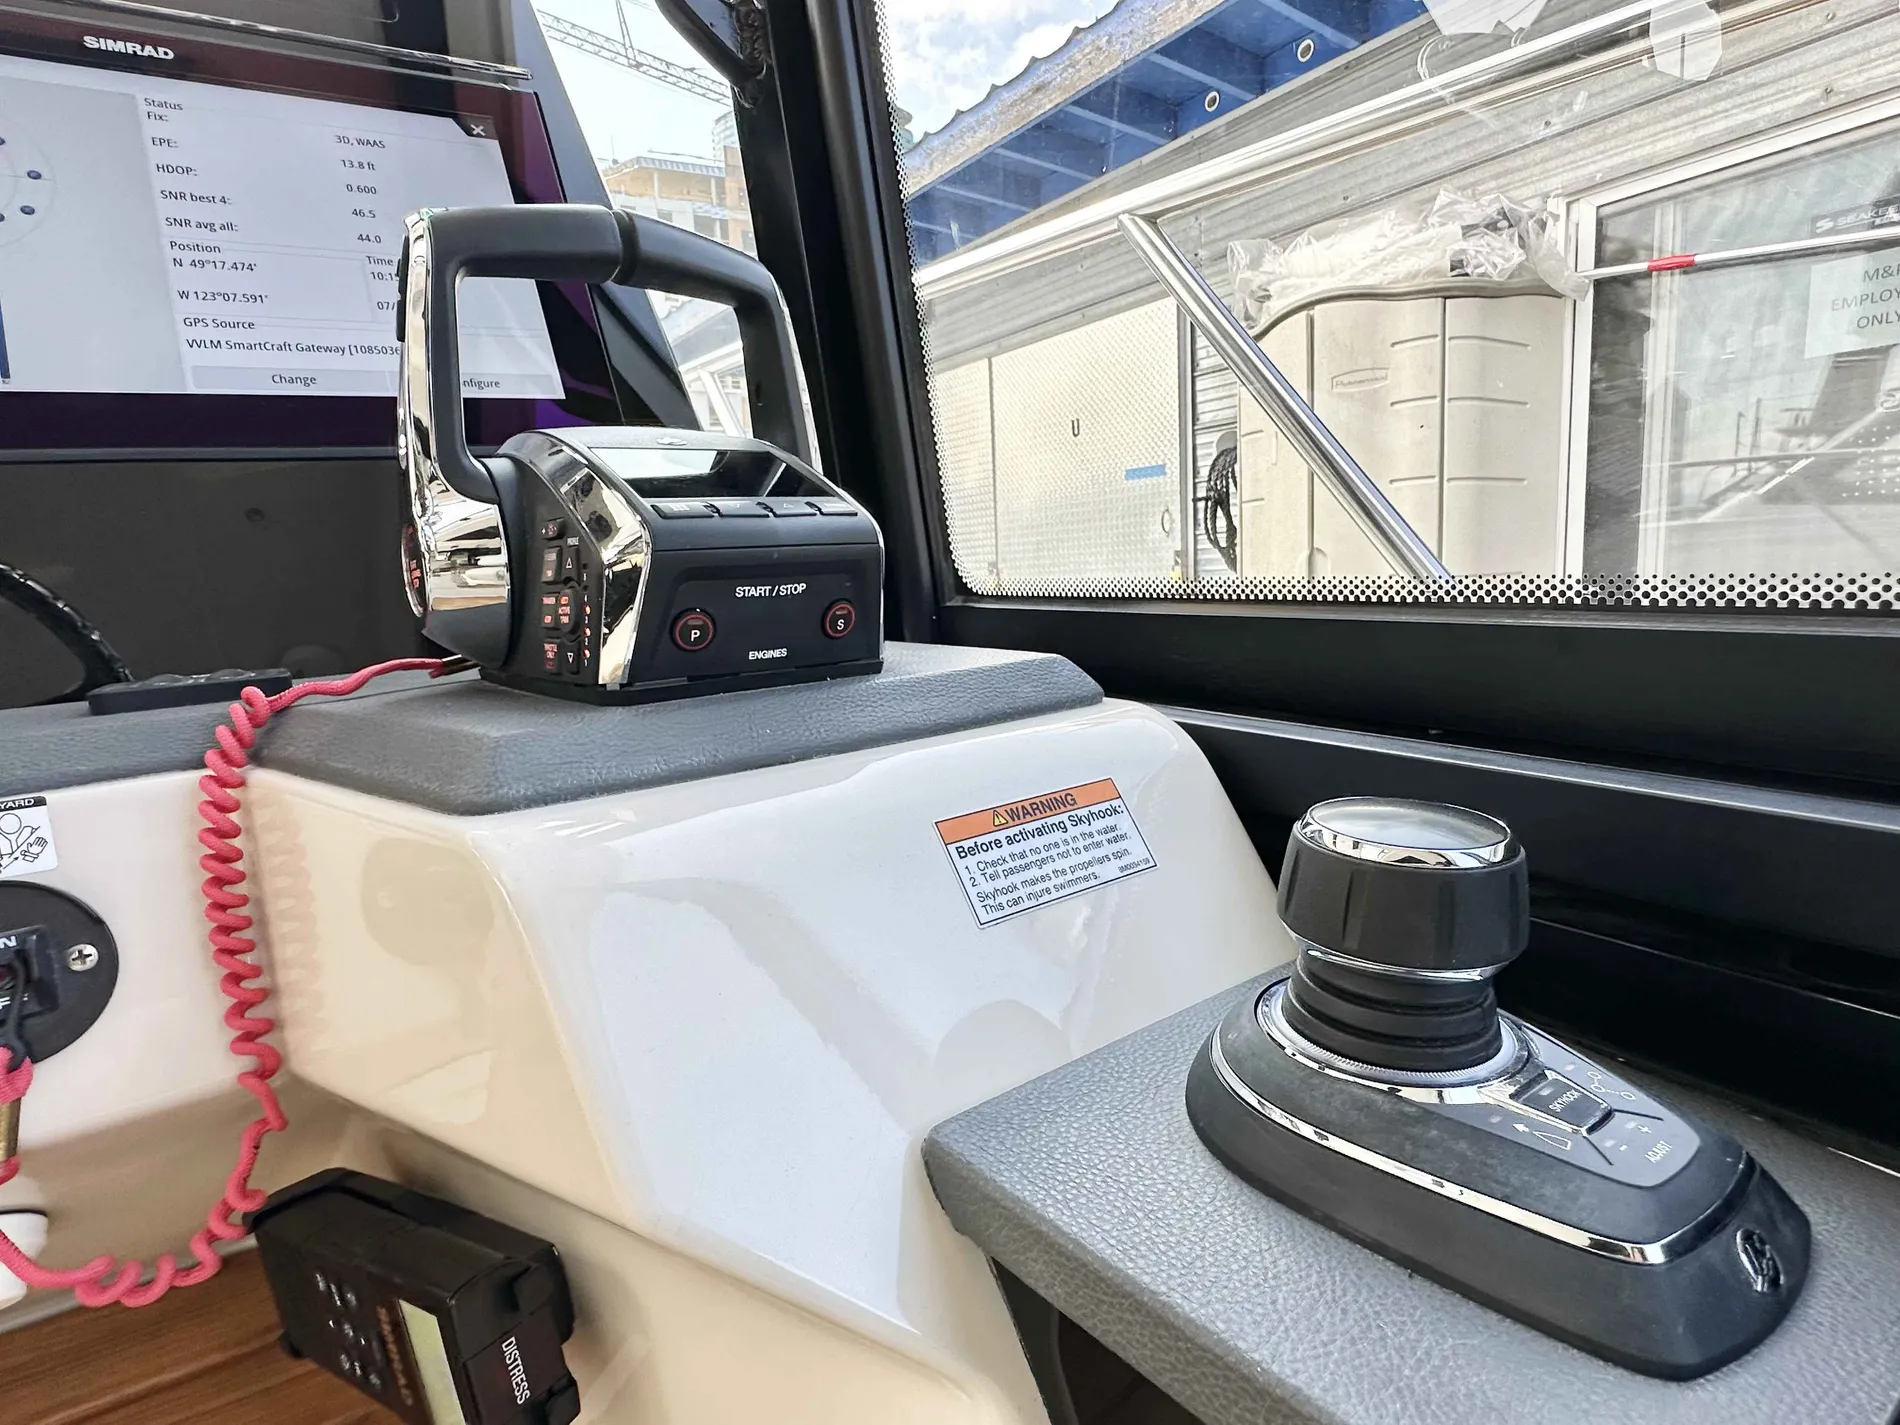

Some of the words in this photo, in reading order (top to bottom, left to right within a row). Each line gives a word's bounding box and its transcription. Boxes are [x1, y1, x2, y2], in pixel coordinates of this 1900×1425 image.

[83, 35, 175, 60] SIMRAD
[144, 97, 183, 111] Status
[147, 111, 169, 122] Fix:
[151, 136, 179, 149] EPE:
[355, 137, 386, 149] WAAS
[156, 163, 198, 177] HDOP:
[341, 159, 365, 171] 13.8
[367, 161, 376, 171] ft
[346, 183, 377, 195] 0.600
[160, 189, 188, 202] SNR
[189, 192, 217, 204] best
[219, 195, 233, 205] 4:
[351, 208, 376, 219] 46.5
[165, 216, 192, 229] SNR
[195, 220, 217, 233] avg
[219, 221, 239, 232] all:
[357, 233, 382, 244] 44.0
[169, 240, 222, 254] Position
[173, 257, 184, 268] N
[366, 255, 394, 267] Time
[177, 289, 190, 301] W
[183, 317, 209, 329] GPS
[211, 318, 256, 331] Source
[225, 339, 293, 352] SmartCraft
[295, 342, 345, 357] Gateway
[271, 373, 317, 387] Change
[735, 586, 771, 597] START
[779, 583, 807, 596] STOP
[836, 619, 845, 632] S
[690, 630, 701, 643] P
[748, 648, 787, 660] ENGINES
[1004, 792, 1078, 822] WARNING
[955, 838, 1003, 860] Before
[1005, 820, 1068, 846] activating
[1067, 804, 1124, 828] Skyhook:
[965, 865, 976, 876] 1.
[976, 855, 1009, 872] Check
[1009, 849, 1028, 863] that
[1029, 846, 1041, 857] no
[1043, 841, 1060, 852] one
[1060, 837, 1070, 847] is
[1071, 834, 1080, 844] in
[1080, 830, 1095, 841] the
[1095, 823, 1121, 837] water.
[969, 876, 981, 887] 2.
[981, 869, 1001, 884] Tell
[1002, 856, 1056, 880] passengers
[1057, 848, 1072, 860] not
[1072, 846, 1081, 855] to
[1083, 840, 1104, 853] enter
[1105, 832, 1131, 846] water.
[976, 881, 1020, 903] Skyhook
[1021, 872, 1052, 890] makes
[1052, 867, 1068, 879] the
[1069, 854, 1111, 875] propellers
[1111, 847, 1132, 861] spin.
[981, 901, 1005, 915] This
[1006, 895, 1025, 908] can
[1025, 886, 1052, 902] injure
[1053, 871, 1100, 893] swimmers.
[1548, 1089, 1582, 1113] SKYHOOK
[1644, 1140, 1673, 1163] ADJUST
[501, 1336, 531, 1405] DISTRESS
